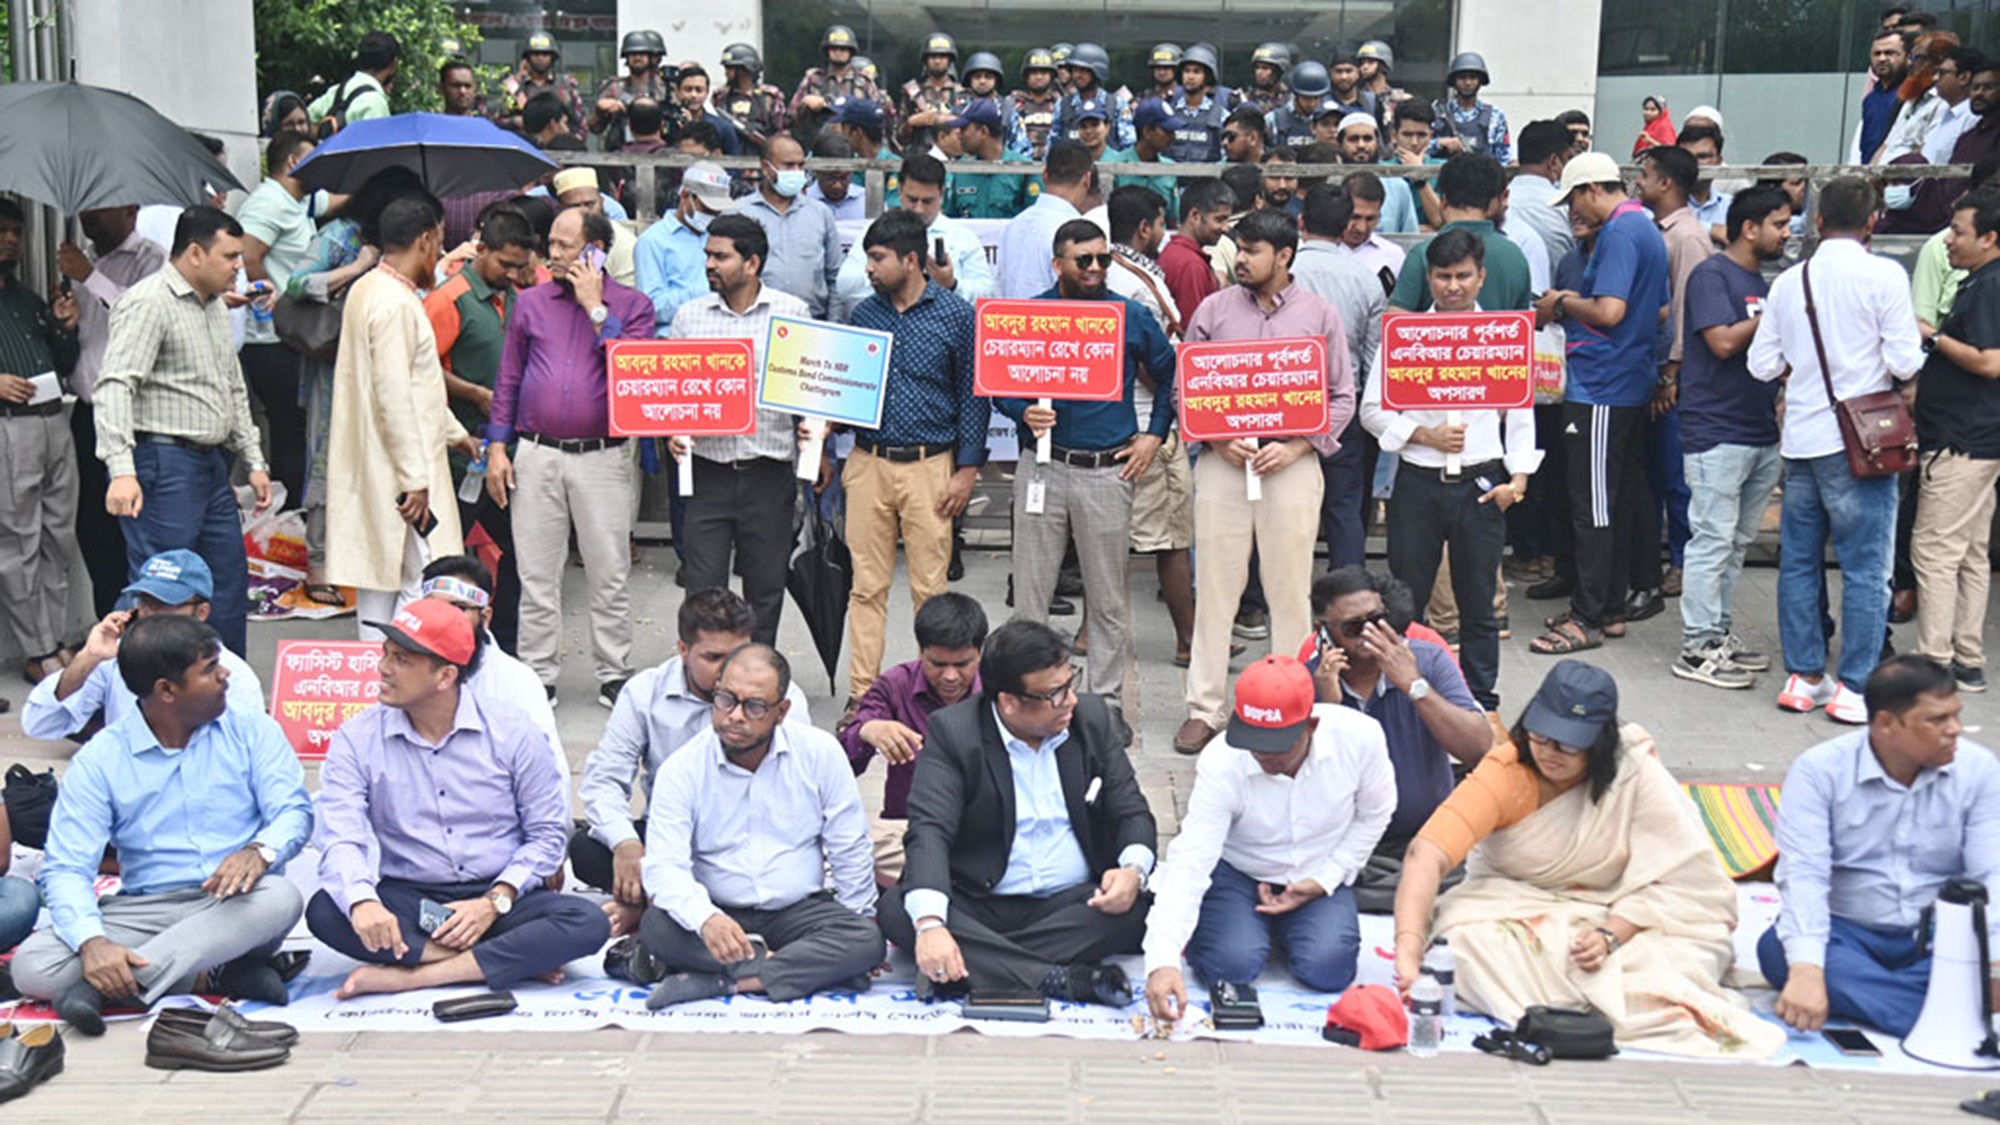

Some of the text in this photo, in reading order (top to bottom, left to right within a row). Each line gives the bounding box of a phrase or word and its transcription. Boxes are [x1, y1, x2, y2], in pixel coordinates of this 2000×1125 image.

[983, 313, 1117, 336] আবদুর রহমান খানকে
[1396, 319, 1520, 344] আলোচনার পূর্বশর্ত
[983, 338, 1115, 360] চেয়ারম্যান রেখে কোন
[1191, 345, 1313, 370] আলোচনার পূর্বশর্ত
[1390, 342, 1525, 361] এনবিআর চেয়ারম্যান
[614, 353, 747, 375] আবদুর রহমান খানকে
[1007, 364, 1090, 384] আলোচনা নয়
[1388, 367, 1433, 385] আবদুর
[1437, 366, 1482, 382] রহমান
[1486, 365, 1528, 381] খানের
[616, 377, 747, 398] চেয়ারম্যান রেখে কোন
[1187, 370, 1319, 390] এনবিআর চেয়ারম্যান
[1185, 390, 1323, 414] আবদুর রহমান খানের
[1427, 385, 1487, 401] অপসারণ
[641, 403, 723, 421] আলোচনা নয়
[1225, 412, 1284, 429] অপসারণ
[285, 649, 380, 673] ফ্যাসিস্ট হাসি
[294, 674, 361, 698] এনবিআর
[282, 701, 337, 727] আবদুর
